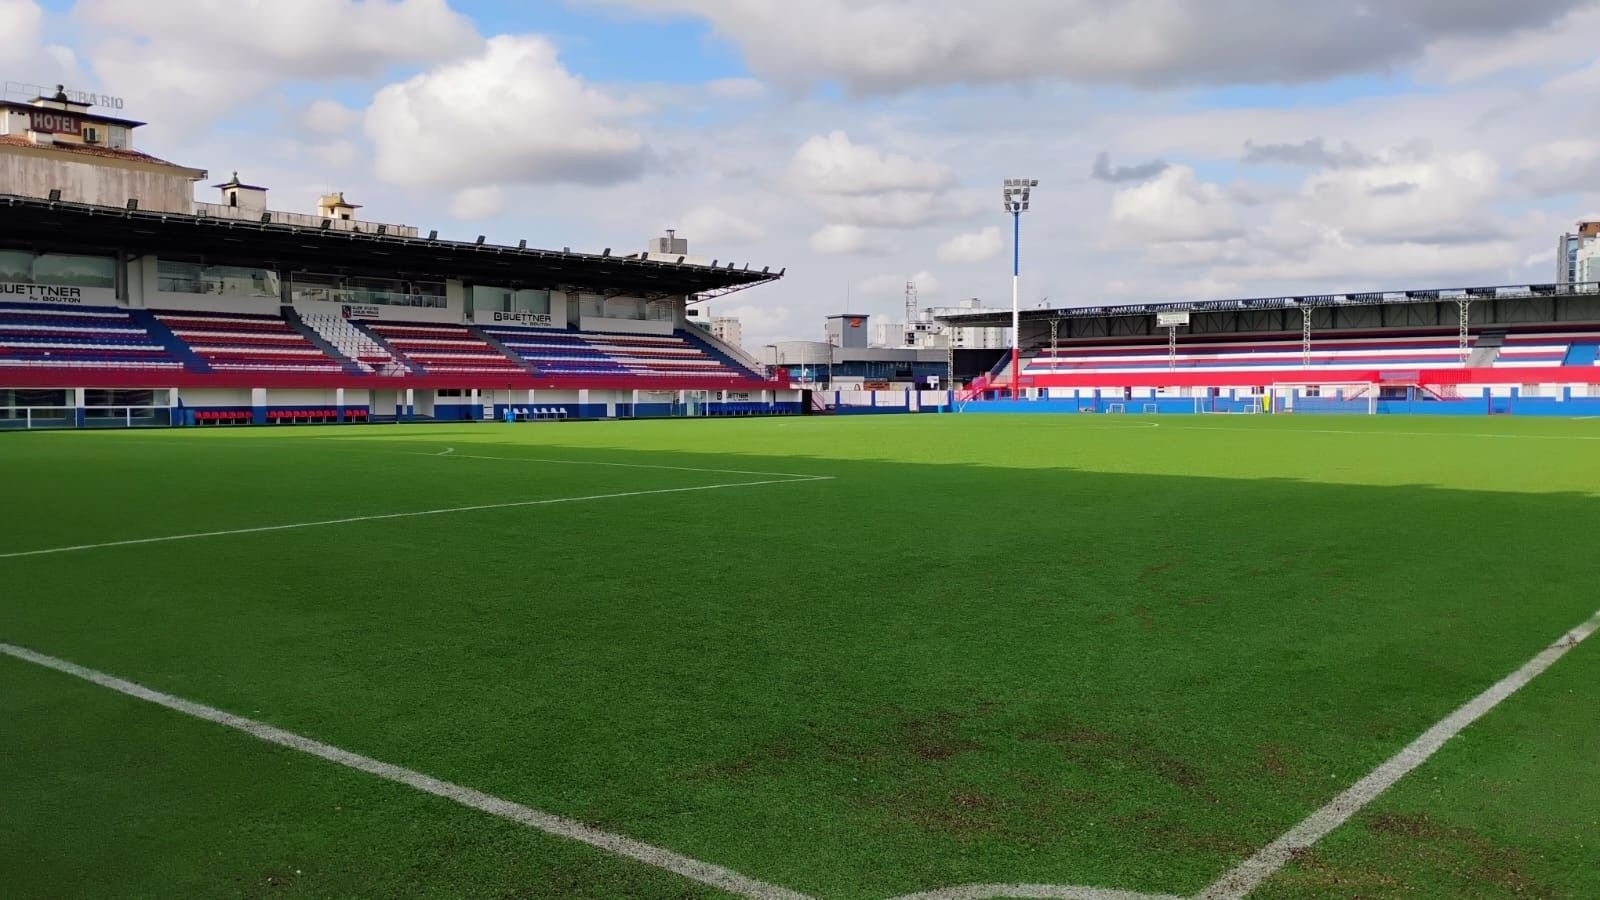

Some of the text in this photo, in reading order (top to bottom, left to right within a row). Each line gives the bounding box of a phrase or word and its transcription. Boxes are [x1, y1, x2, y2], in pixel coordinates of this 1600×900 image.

[101, 95, 124, 109] RIO
[33, 113, 78, 132] HOTEL
[42, 295, 81, 303] BOUTON
[502, 312, 551, 322] BUETTNER
